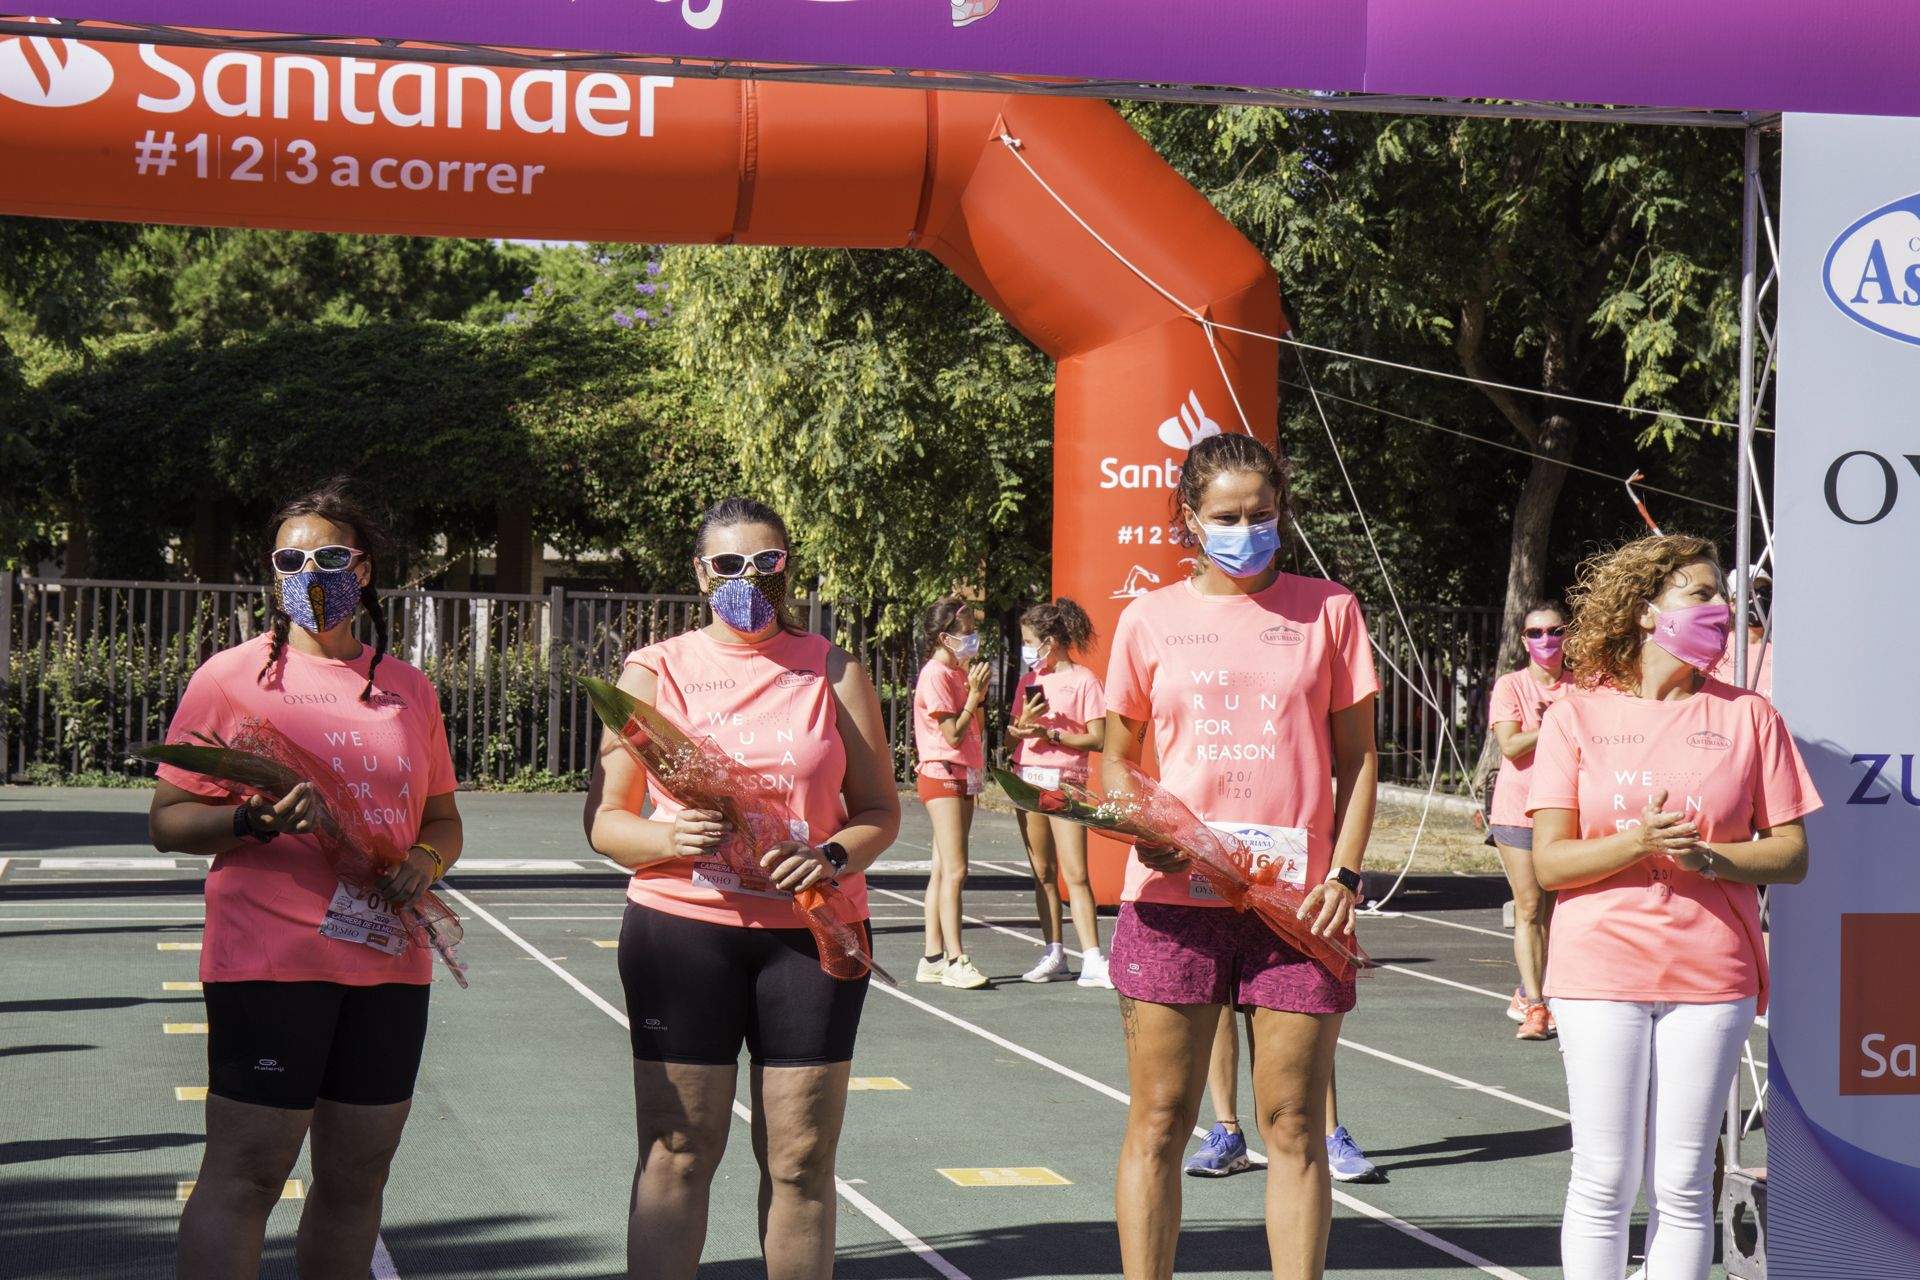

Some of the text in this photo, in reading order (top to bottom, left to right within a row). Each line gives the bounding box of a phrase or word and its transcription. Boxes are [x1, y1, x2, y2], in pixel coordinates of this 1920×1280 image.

[136, 43, 675, 138] Santander
[331, 154, 361, 187] a
[369, 156, 546, 195] correr
[1100, 457, 1182, 489] Sant
[1165, 633, 1219, 646] OYSHO
[1192, 670, 1229, 685] WE
[684, 678, 736, 694] OYSHO
[283, 693, 337, 705] OYSHO
[707, 711, 744, 726] WE
[1195, 719, 1276, 735] FOR A
[325, 731, 363, 746] WE
[1591, 734, 1644, 745] OYSHO
[781, 750, 796, 765] A
[1197, 744, 1275, 760] REASON
[1614, 770, 1653, 785] WE
[399, 782, 410, 797] A
[698, 873, 731, 886] OYSHO
[1860, 1032, 1918, 1079] Sa
